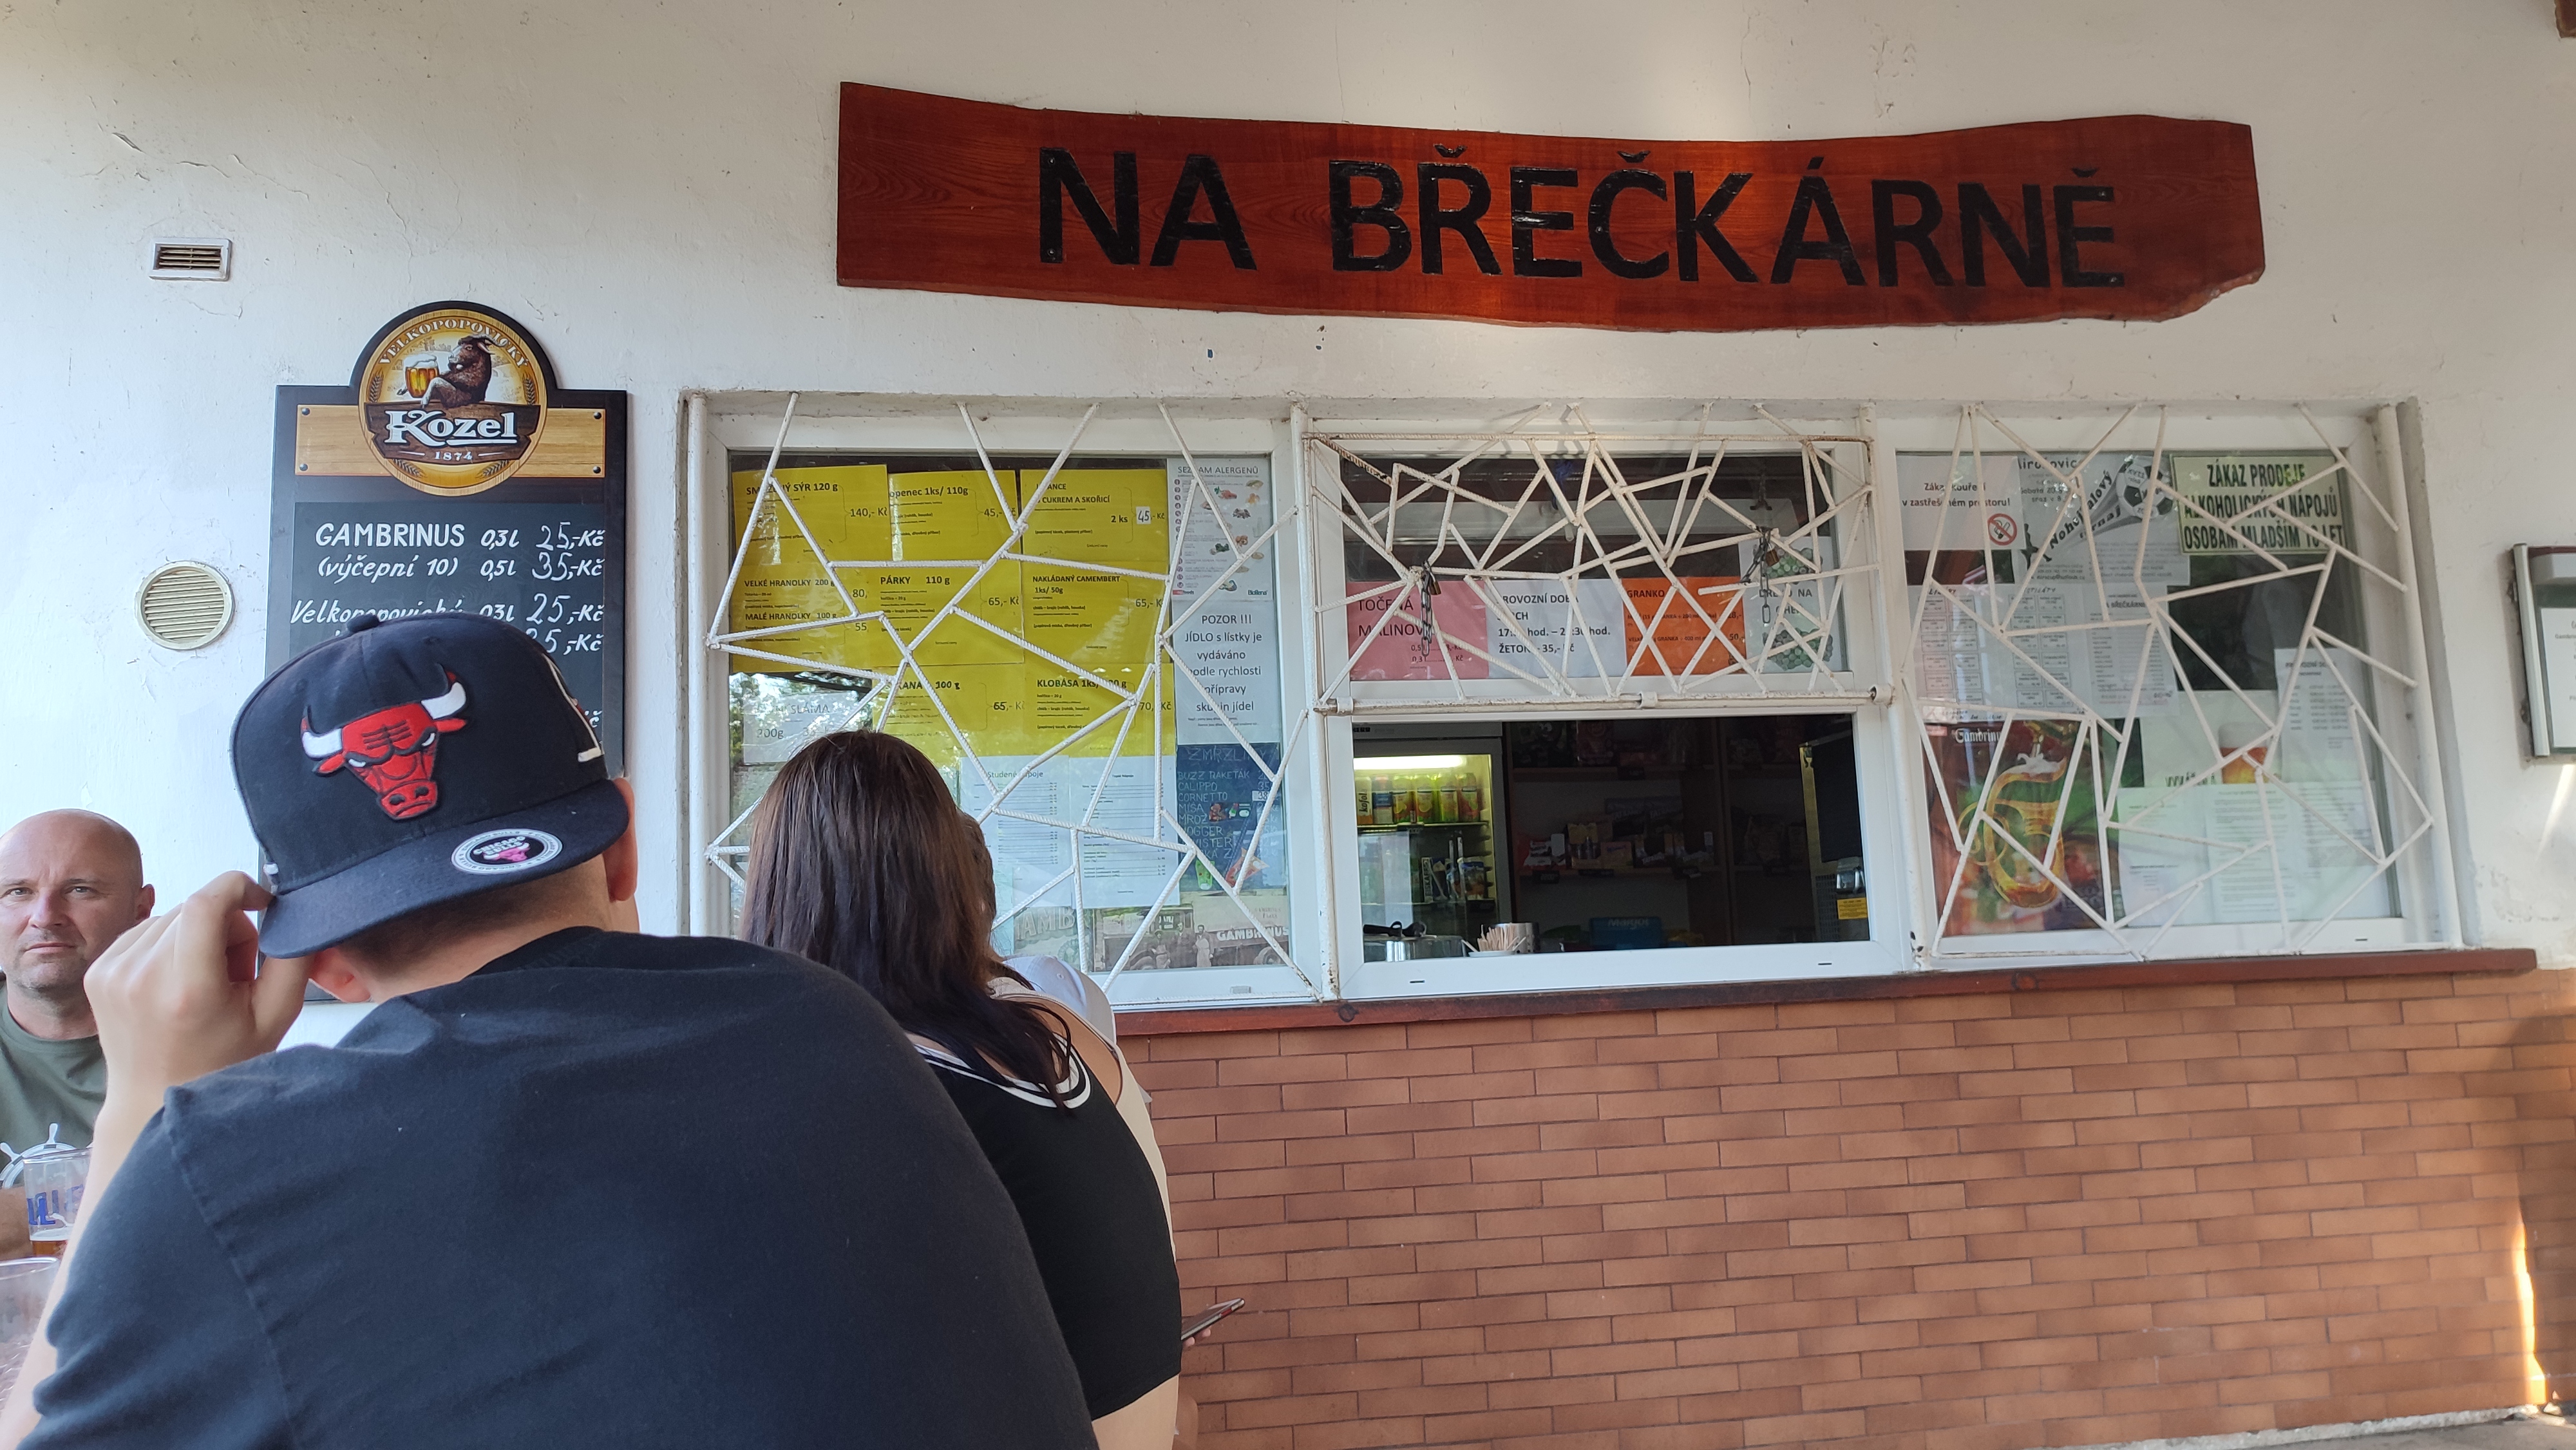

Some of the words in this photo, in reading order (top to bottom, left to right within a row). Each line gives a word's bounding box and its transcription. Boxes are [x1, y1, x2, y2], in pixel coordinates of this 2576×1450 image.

[1039, 146, 1256, 271] NA
[1329, 143, 2124, 288] BŘEČKÁRNĚ
[379, 319, 529, 368] VELKOPOPOVICKÝ
[384, 410, 518, 447] Kozel
[435, 451, 473, 462] 1874
[1178, 466, 1212, 475] SEZAM
[1215, 466, 1258, 475] ALERGENŮ
[2206, 458, 2247, 487] ZÁKAZ
[2249, 464, 2306, 487] PRODEJE
[746, 482, 791, 496] SMŽÝ
[793, 482, 811, 492] SÝR
[813, 482, 830, 492] 120
[831, 483, 838, 493] g
[889, 488, 922, 499] openec
[925, 486, 943, 496] 1ks/
[947, 485, 969, 496] 110g
[1924, 482, 1946, 491] Záka
[1951, 482, 1985, 491] kouřeí
[1082, 494, 1110, 504] SKOŘICÍ
[1910, 498, 1965, 507] zastřešném
[2289, 486, 2338, 518] NÁPOJŮ
[850, 507, 875, 518] 140,-
[983, 507, 1003, 517] 45,-
[1119, 514, 1128, 523] ks
[315, 523, 466, 547] GAMBRINUS
[480, 529, 520, 551] 0,3l
[535, 522, 605, 551] 25,-Kč
[317, 553, 419, 584] (výčepní
[426, 556, 459, 577] 10)
[480, 558, 517, 582] 0,5l
[531, 552, 605, 581] 35,-Kč
[744, 578, 768, 587] VELKÉ
[880, 575, 911, 585] PÁRKY
[925, 576, 942, 585] 110
[944, 577, 951, 585] g
[1502, 592, 1548, 604] ROVOZNÍ
[1627, 589, 1665, 598] GRANKO
[1798, 588, 1812, 598] NA
[988, 596, 1007, 607] 65,-
[1135, 598, 1153, 607] 65,-
[290, 598, 464, 625] Velkopovik
[480, 603, 515, 623] 03l
[526, 593, 604, 625] 25,-Kč
[745, 610, 768, 620] MALÉ
[1202, 615, 1237, 625] POZOR
[1240, 614, 1252, 624] !!!
[1184, 631, 1213, 642] JÍDLO
[1224, 632, 1250, 643] lístky
[1253, 633, 1262, 643] je
[1498, 628, 1517, 637] 17:
[1528, 627, 1549, 637] hod.
[1589, 626, 1611, 636] hod.
[1542, 645, 1560, 654] 35,-
[1197, 650, 1246, 662] vydáváno
[1218, 666, 1262, 677] rychlosti
[1037, 678, 1079, 688] KLOBÁSA
[993, 701, 1012, 711] 65,-
[1161, 701, 1171, 710] Kč
[1196, 701, 1229, 713] skuin
[1232, 701, 1254, 713] jídel
[1955, 728, 2002, 744] Gambrinu
[1209, 770, 1250, 780] RAKETÁK
[1178, 782, 1218, 791] CALIPPO
[1258, 782, 1270, 791] 35
[1178, 792, 1227, 802] CORNETTO
[1179, 802, 1204, 813] MÍŠA
[1184, 826, 1224, 837] OGGER
[473, 836, 526, 854] CHICAGO
[484, 840, 523, 856] BULLS
[1193, 837, 1233, 848] ISTER
[1217, 926, 1289, 941] GAMBRNUS
